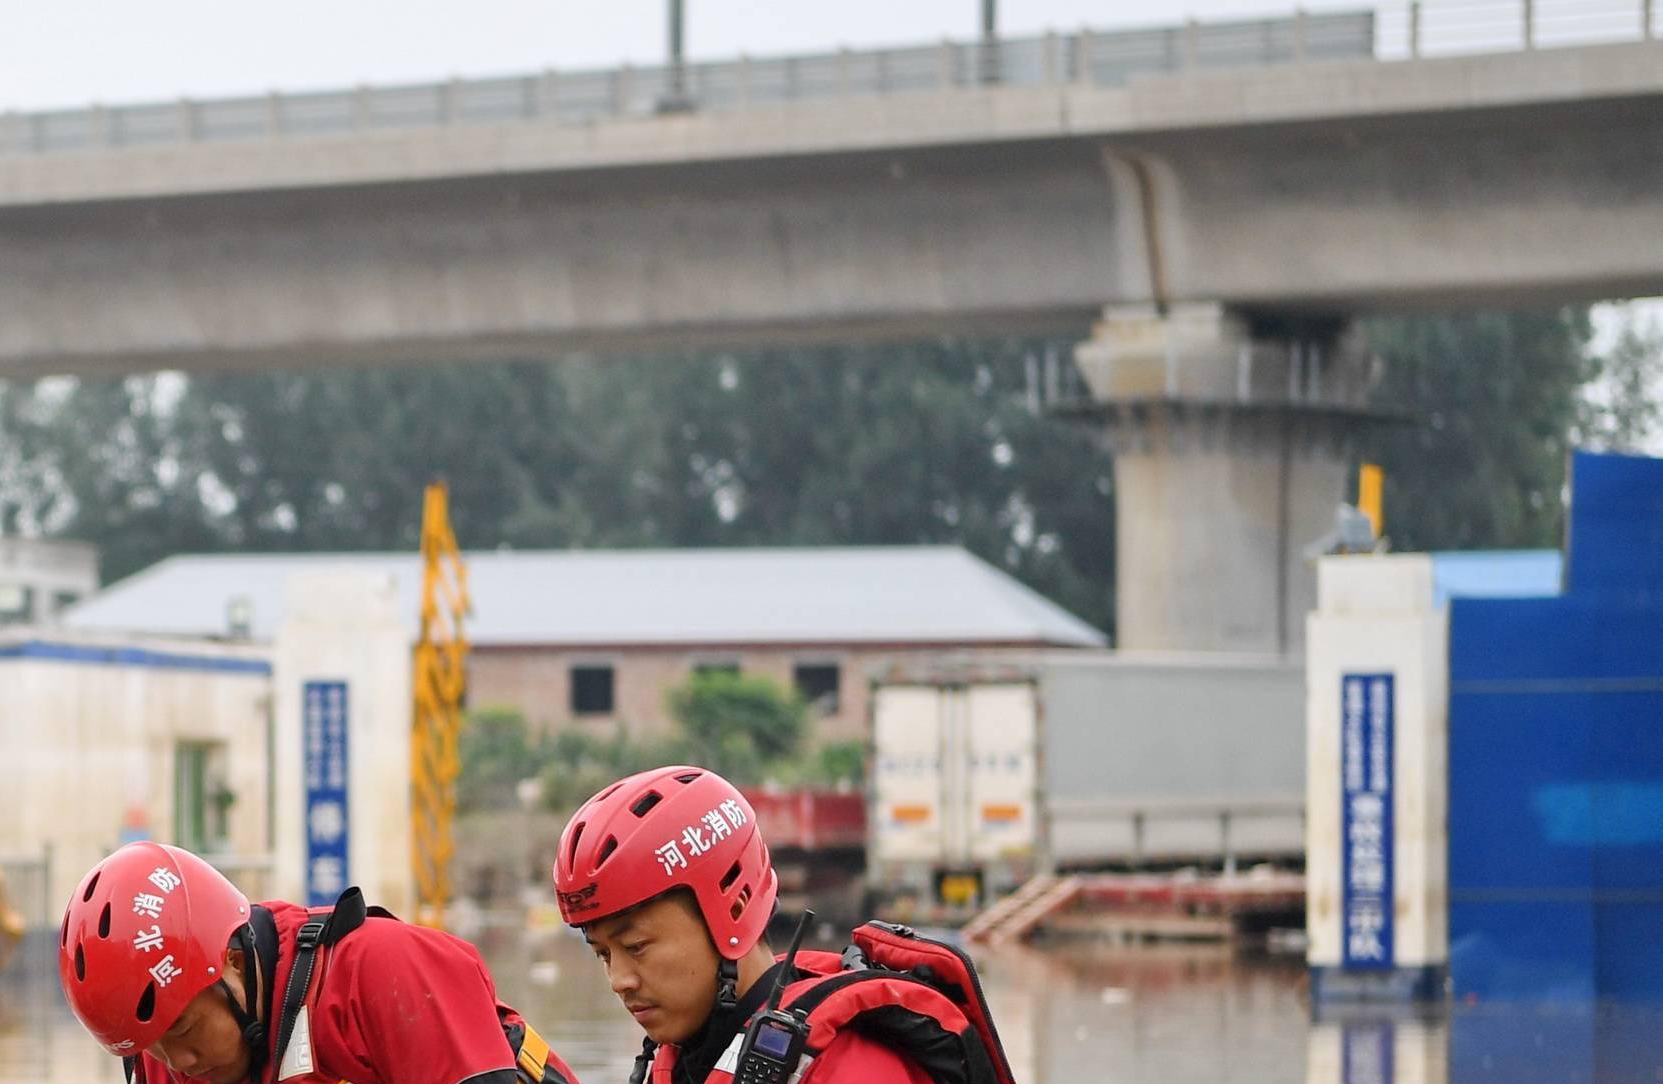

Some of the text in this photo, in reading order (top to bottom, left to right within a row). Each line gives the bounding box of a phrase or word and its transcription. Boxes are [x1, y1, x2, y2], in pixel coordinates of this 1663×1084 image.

[653, 798, 748, 876] 河北消防
[131, 867, 183, 988] 河北消防
